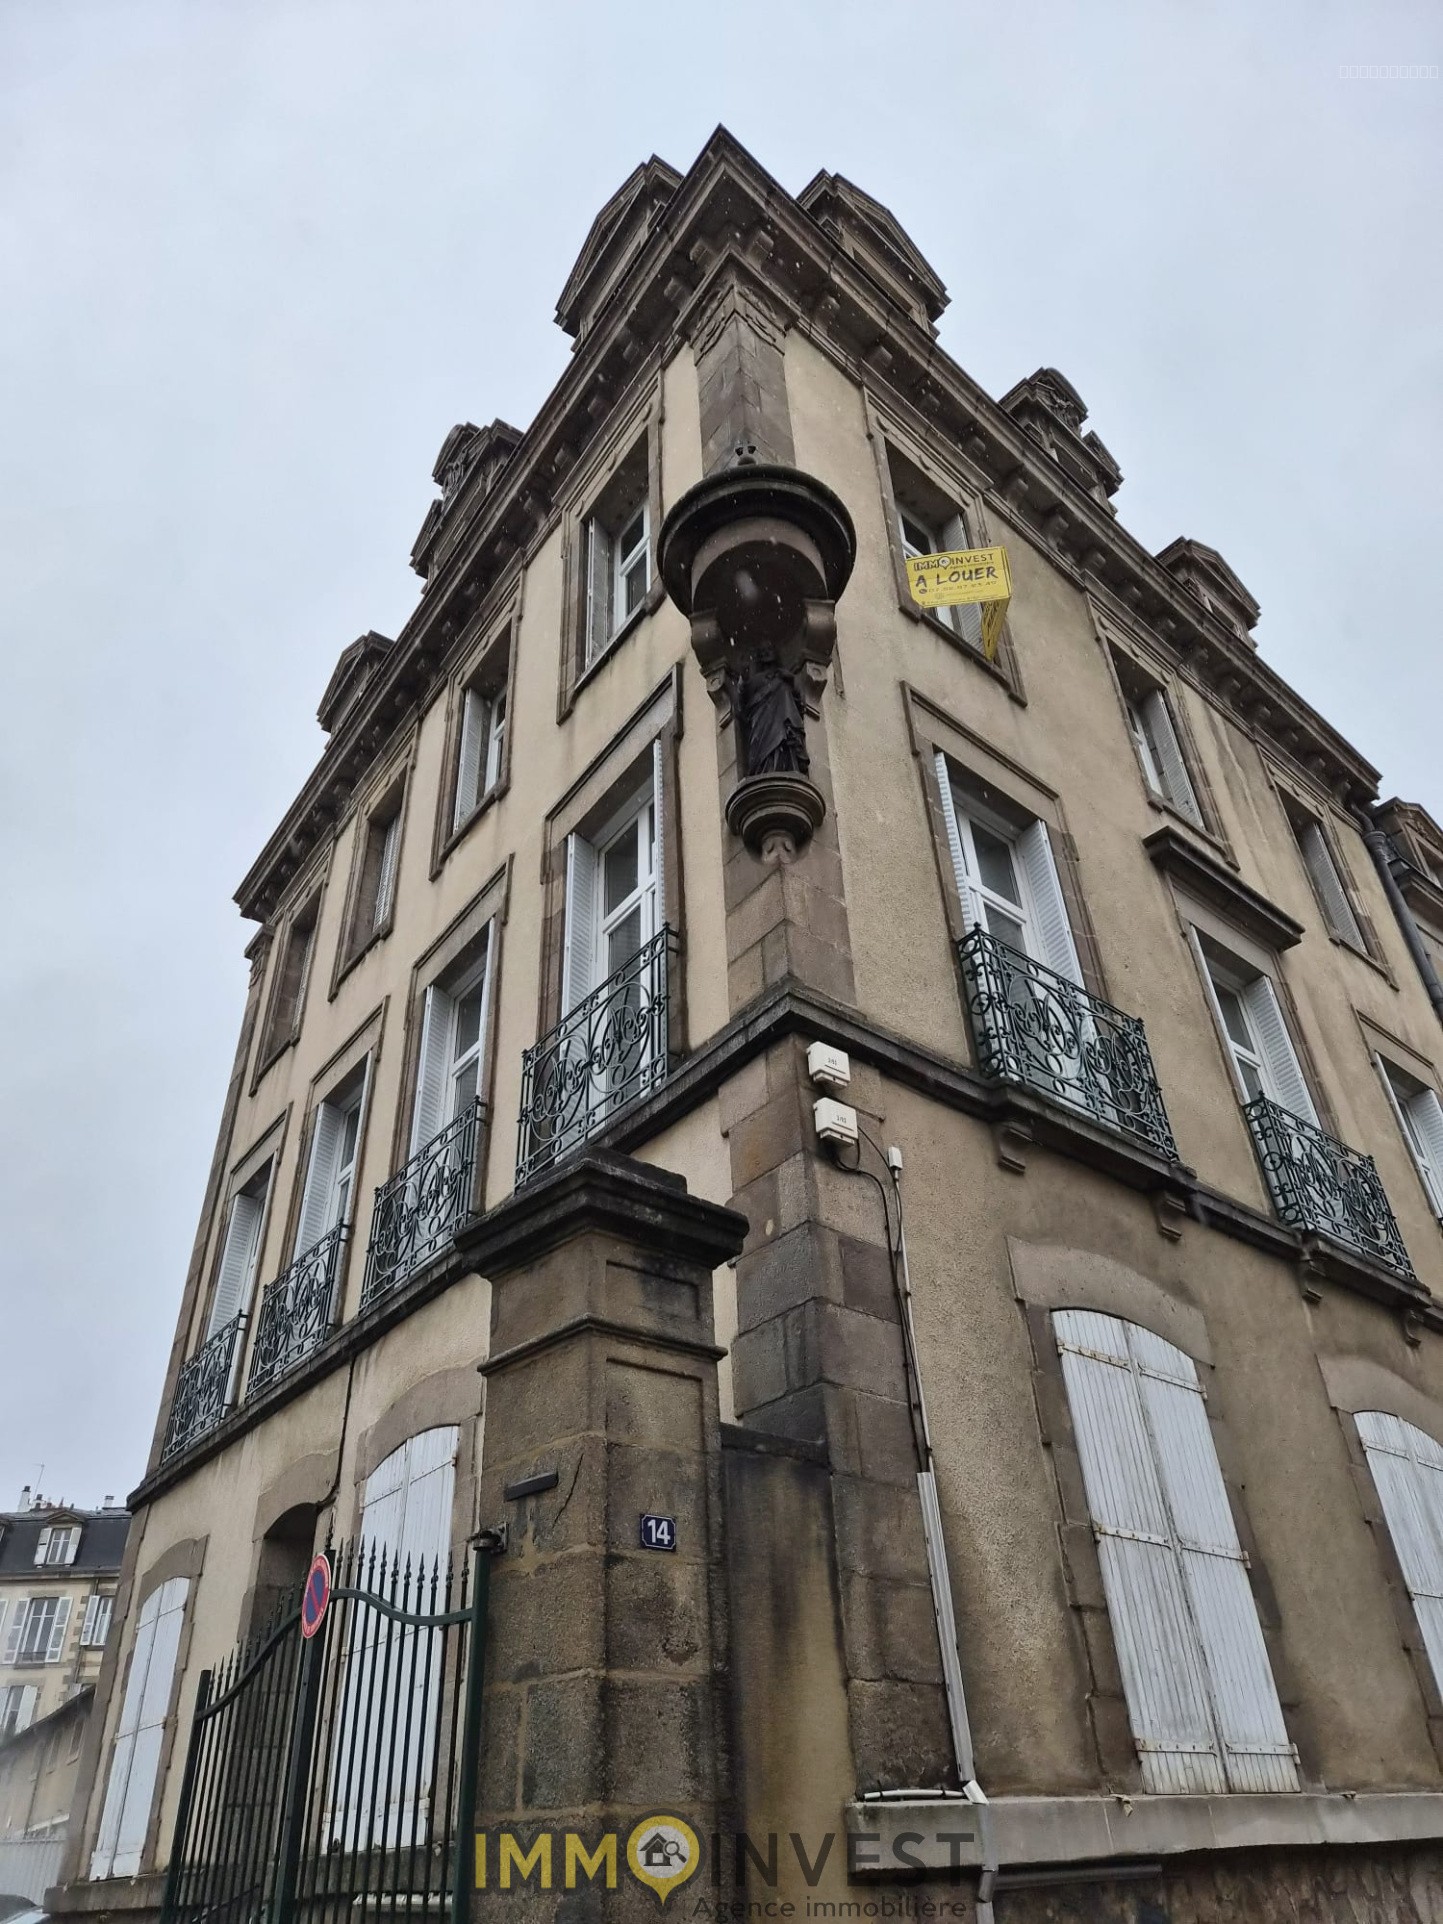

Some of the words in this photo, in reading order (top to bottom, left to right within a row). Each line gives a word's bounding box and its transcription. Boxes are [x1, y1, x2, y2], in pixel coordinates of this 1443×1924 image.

[916, 574, 927, 588] A
[936, 566, 999, 585] LOUER
[647, 1519, 671, 1545] 14
